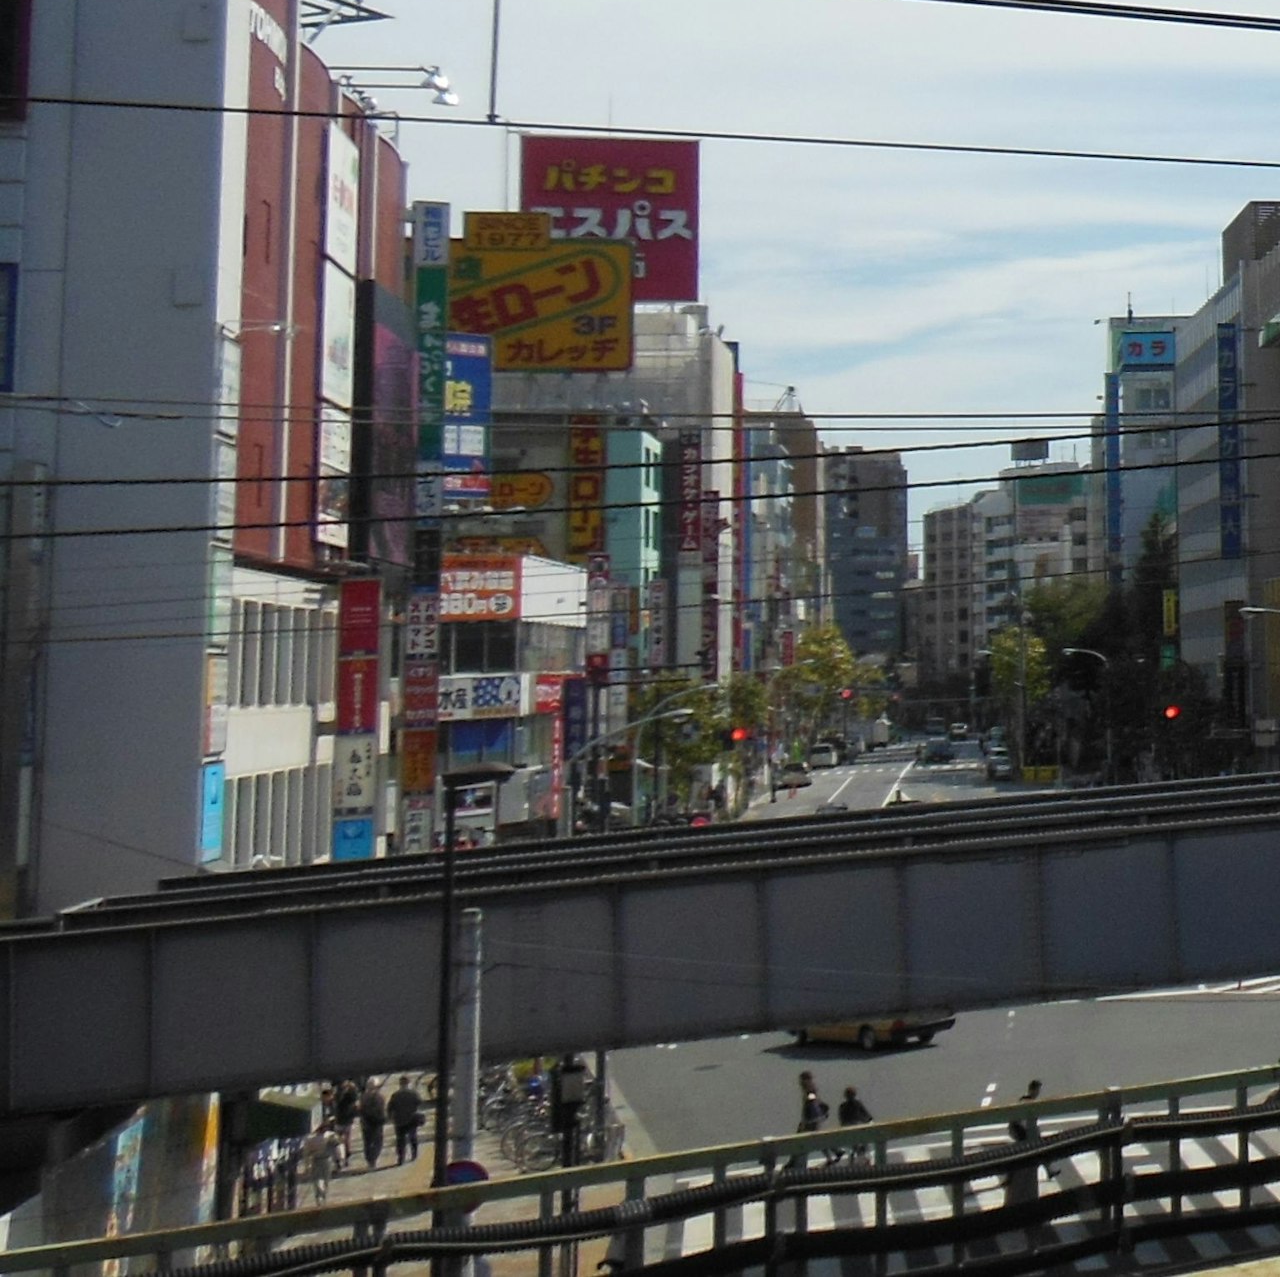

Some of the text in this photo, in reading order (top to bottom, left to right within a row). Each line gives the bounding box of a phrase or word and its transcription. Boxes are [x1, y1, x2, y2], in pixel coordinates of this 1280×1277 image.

[542, 158, 677, 194] パチンコ
[527, 200, 694, 240] エスパス
[475, 232, 541, 247] 1977
